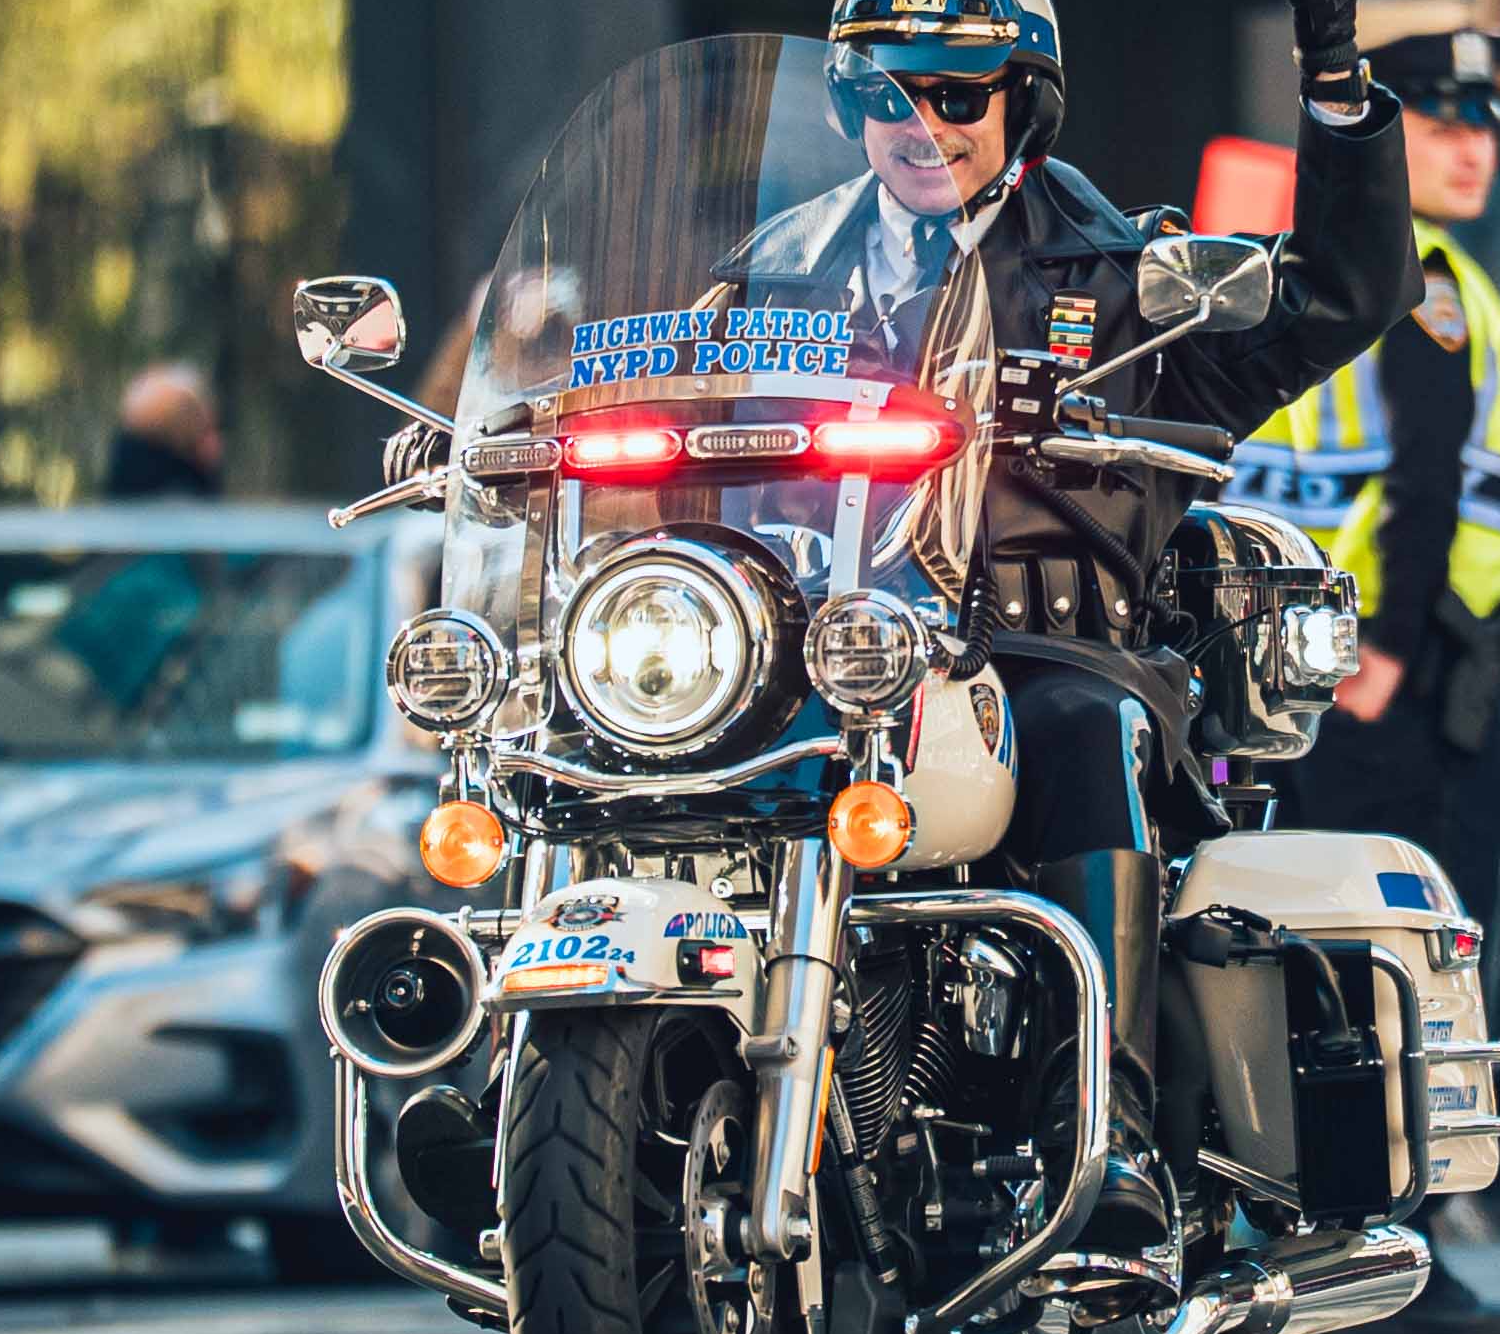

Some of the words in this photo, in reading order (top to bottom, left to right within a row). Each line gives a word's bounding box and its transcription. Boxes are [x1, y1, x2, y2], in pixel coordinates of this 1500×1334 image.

[572, 308, 716, 355] HIGHWAY
[725, 307, 853, 343] PATROL
[569, 344, 678, 388] NYPD
[692, 341, 849, 377] POLICE
[685, 913, 734, 939] POLICE
[511, 936, 610, 968] 2102
[608, 948, 636, 964] 24
